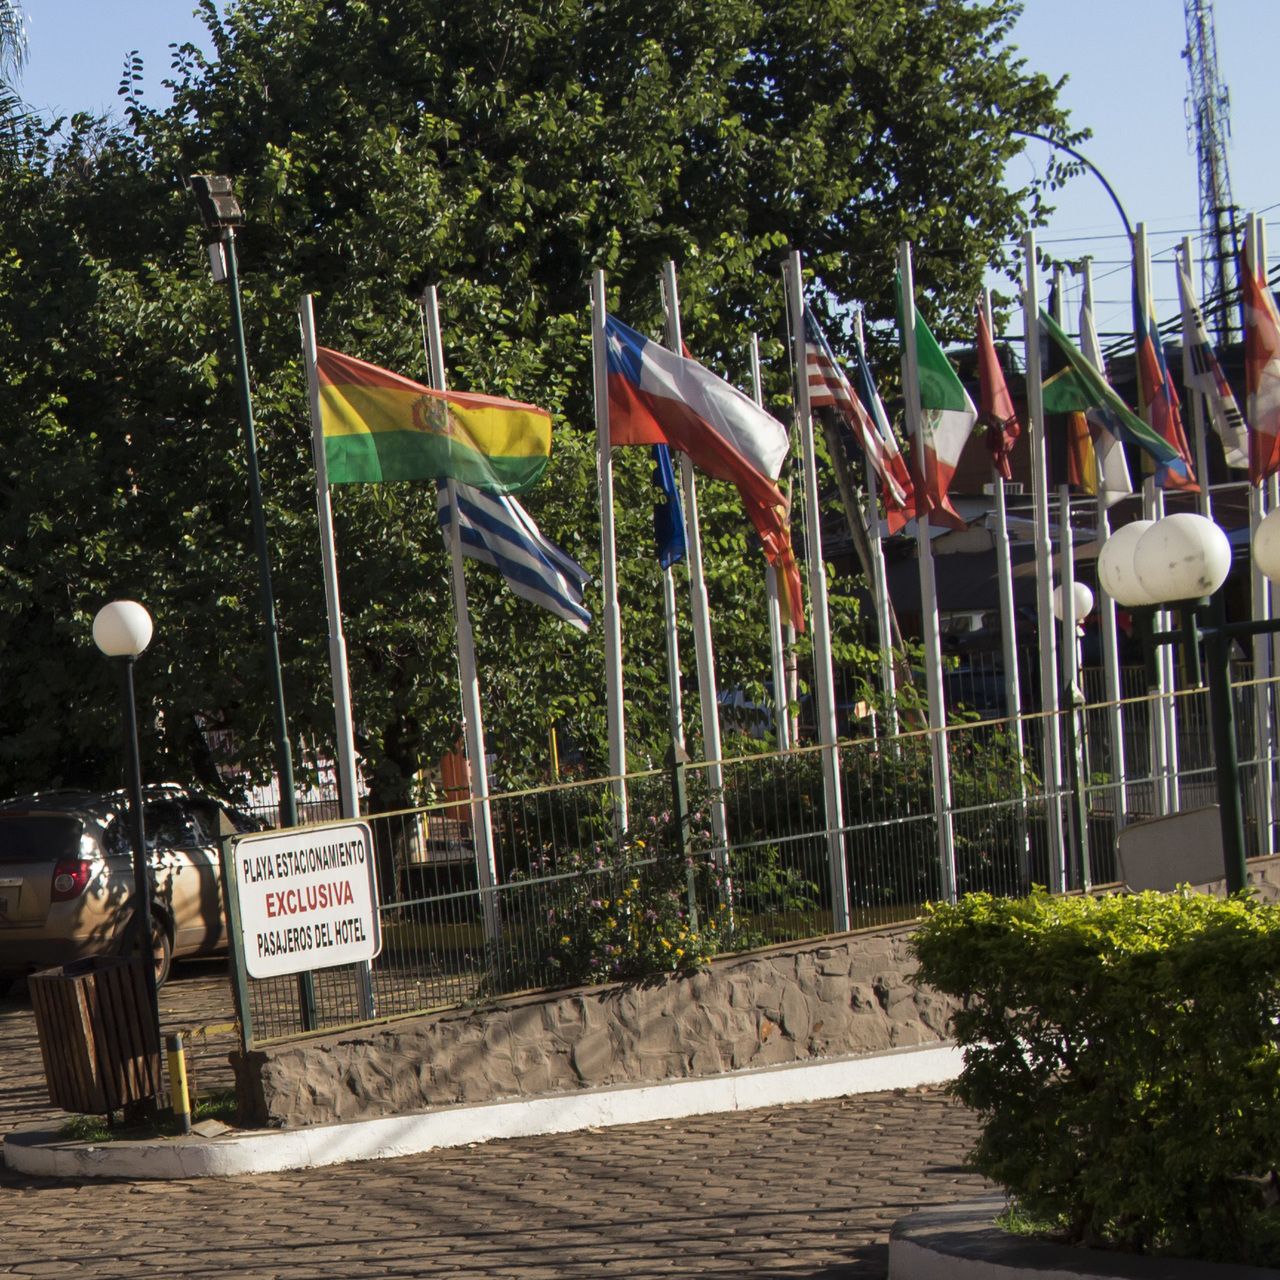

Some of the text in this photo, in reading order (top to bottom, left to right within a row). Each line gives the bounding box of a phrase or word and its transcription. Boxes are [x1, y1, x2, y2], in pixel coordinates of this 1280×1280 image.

[243, 839, 365, 884] PLAYA ESTACIONAMIENTO
[266, 880, 354, 918] EXCLUSIVA
[257, 917, 366, 957] PASAJEROS DEL HOTEL
